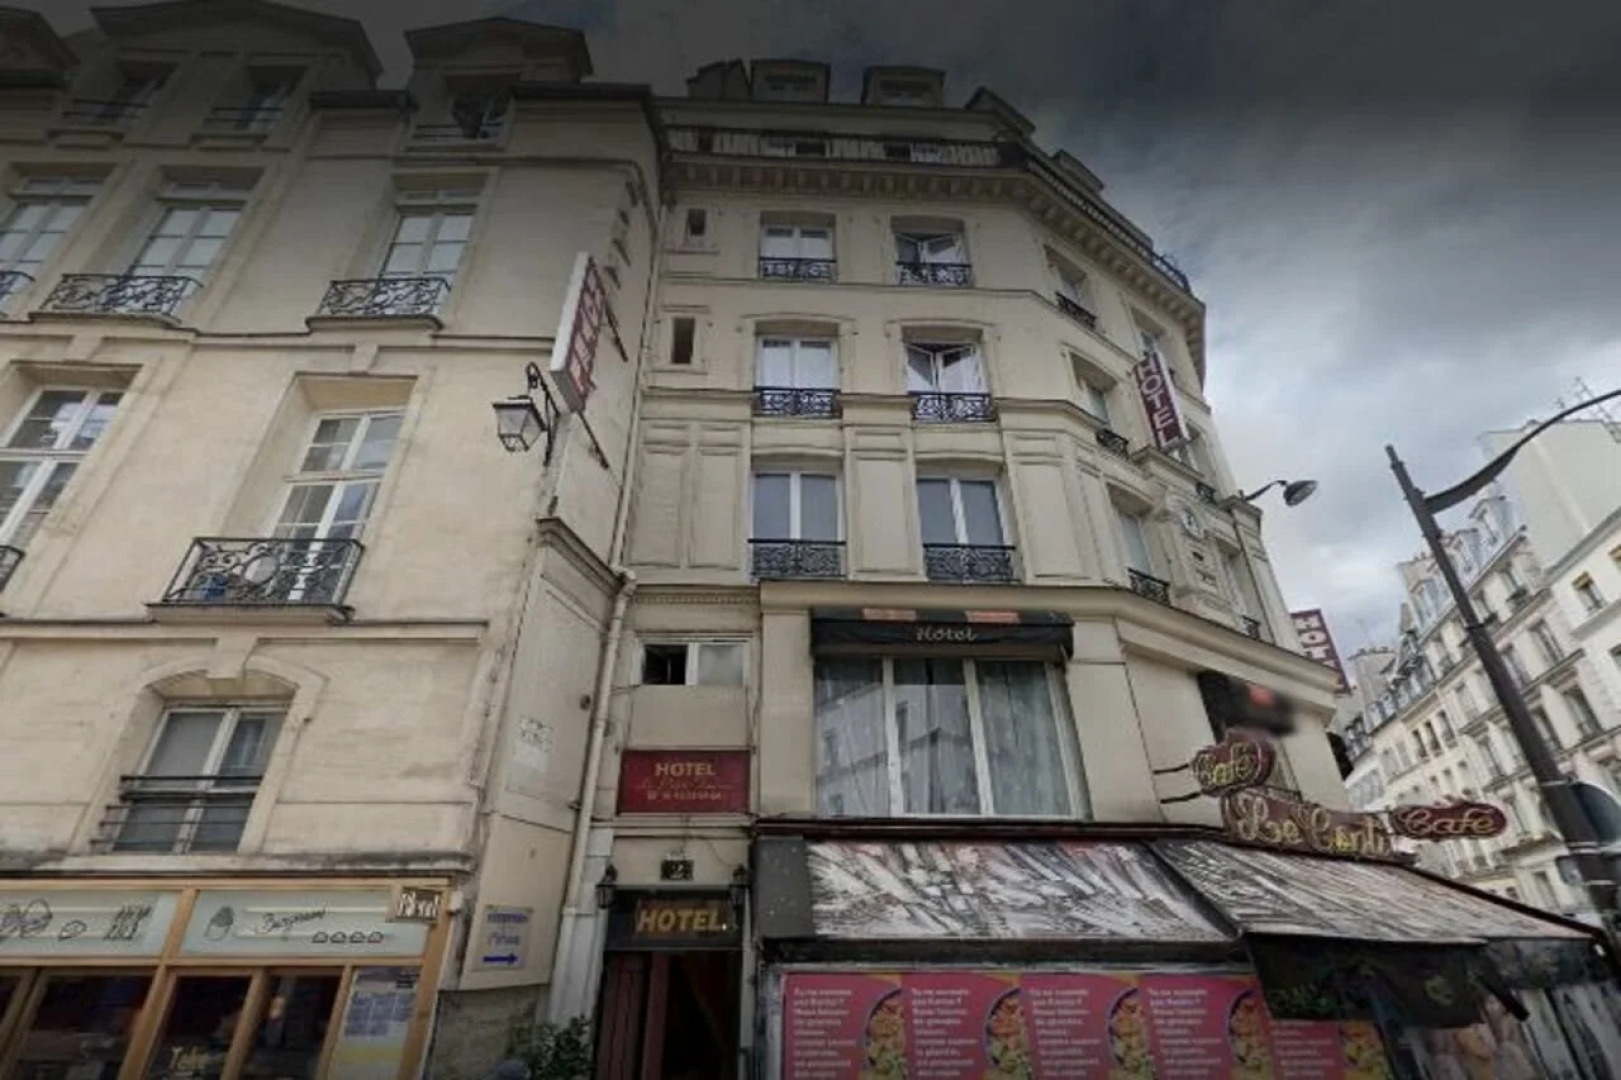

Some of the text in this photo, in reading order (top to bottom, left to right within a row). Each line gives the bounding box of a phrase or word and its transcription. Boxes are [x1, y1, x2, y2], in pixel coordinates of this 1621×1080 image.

[1137, 354, 1180, 447] HOTEL
[1294, 614, 1340, 682] HOT
[655, 762, 717, 776] HOTEL
[638, 909, 722, 932] HOTEL
